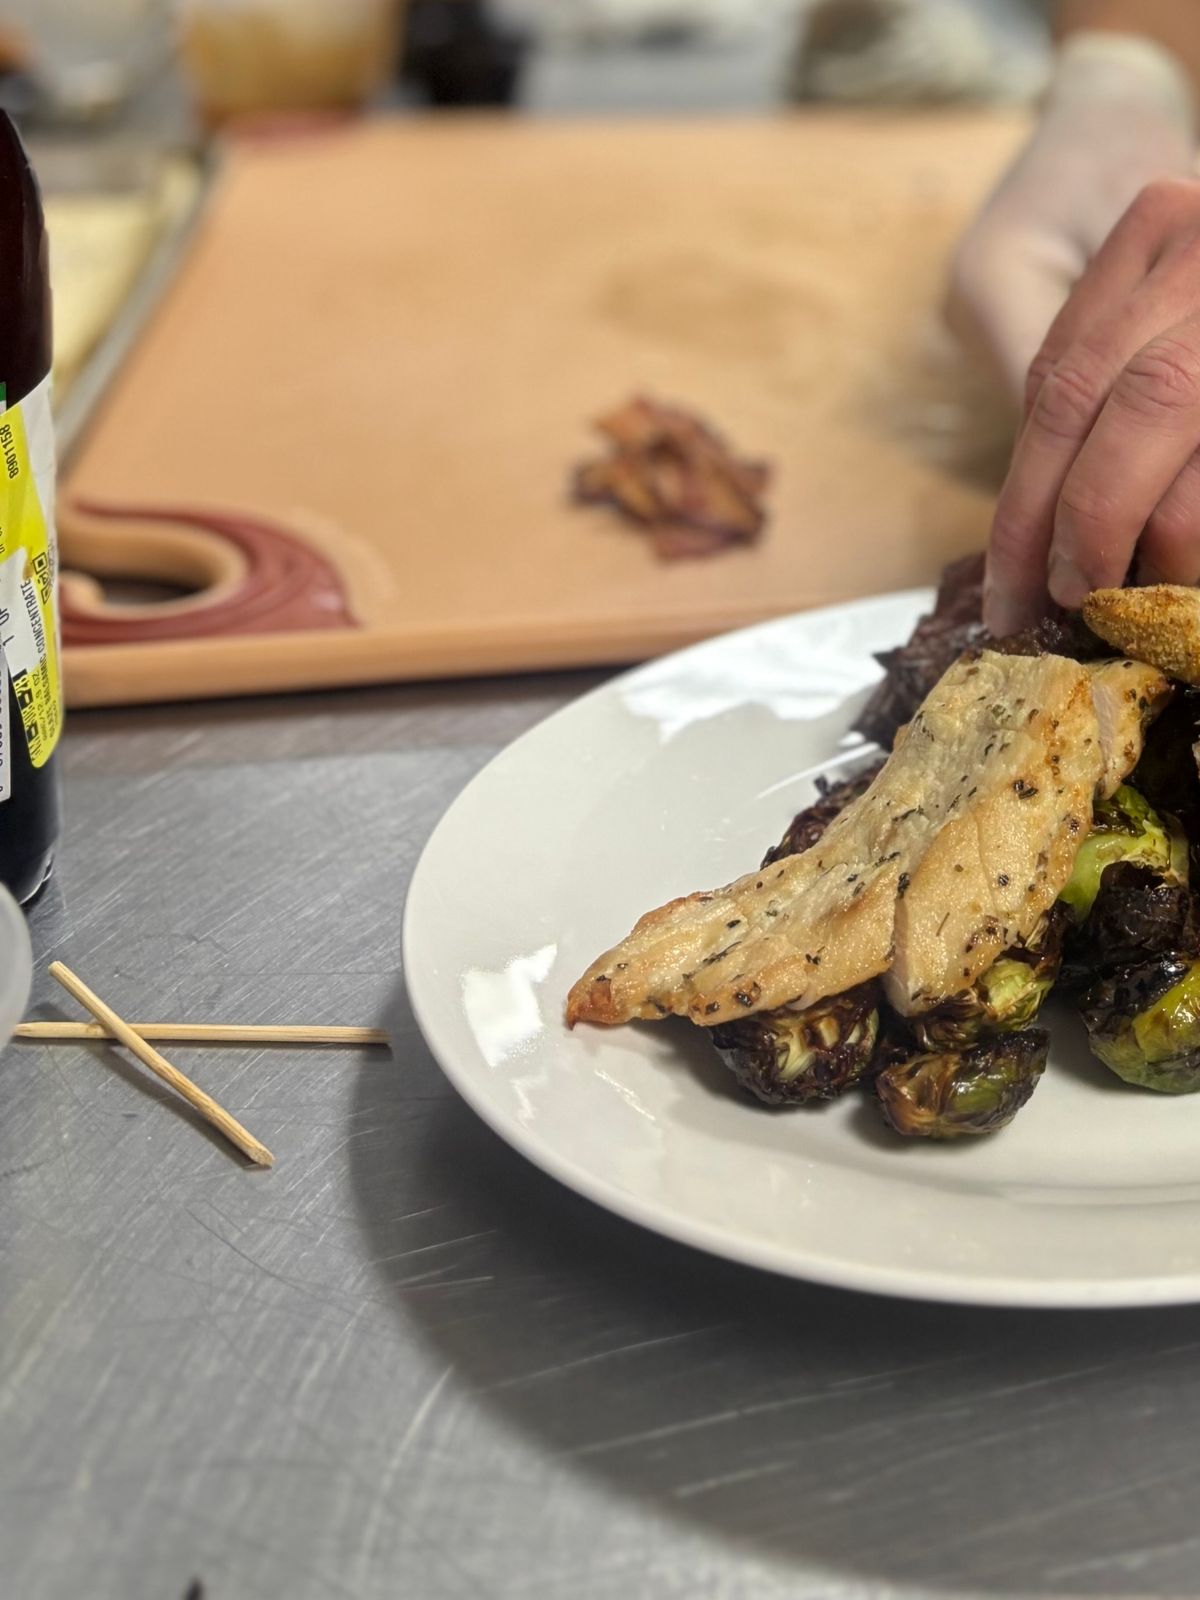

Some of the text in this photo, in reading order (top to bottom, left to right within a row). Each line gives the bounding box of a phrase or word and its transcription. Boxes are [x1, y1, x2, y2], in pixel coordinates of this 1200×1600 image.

[0, 424, 19, 479] 8901158
[21, 578, 46, 653] CONCENTRATE
[39, 654, 52, 704] BALSAMIC
